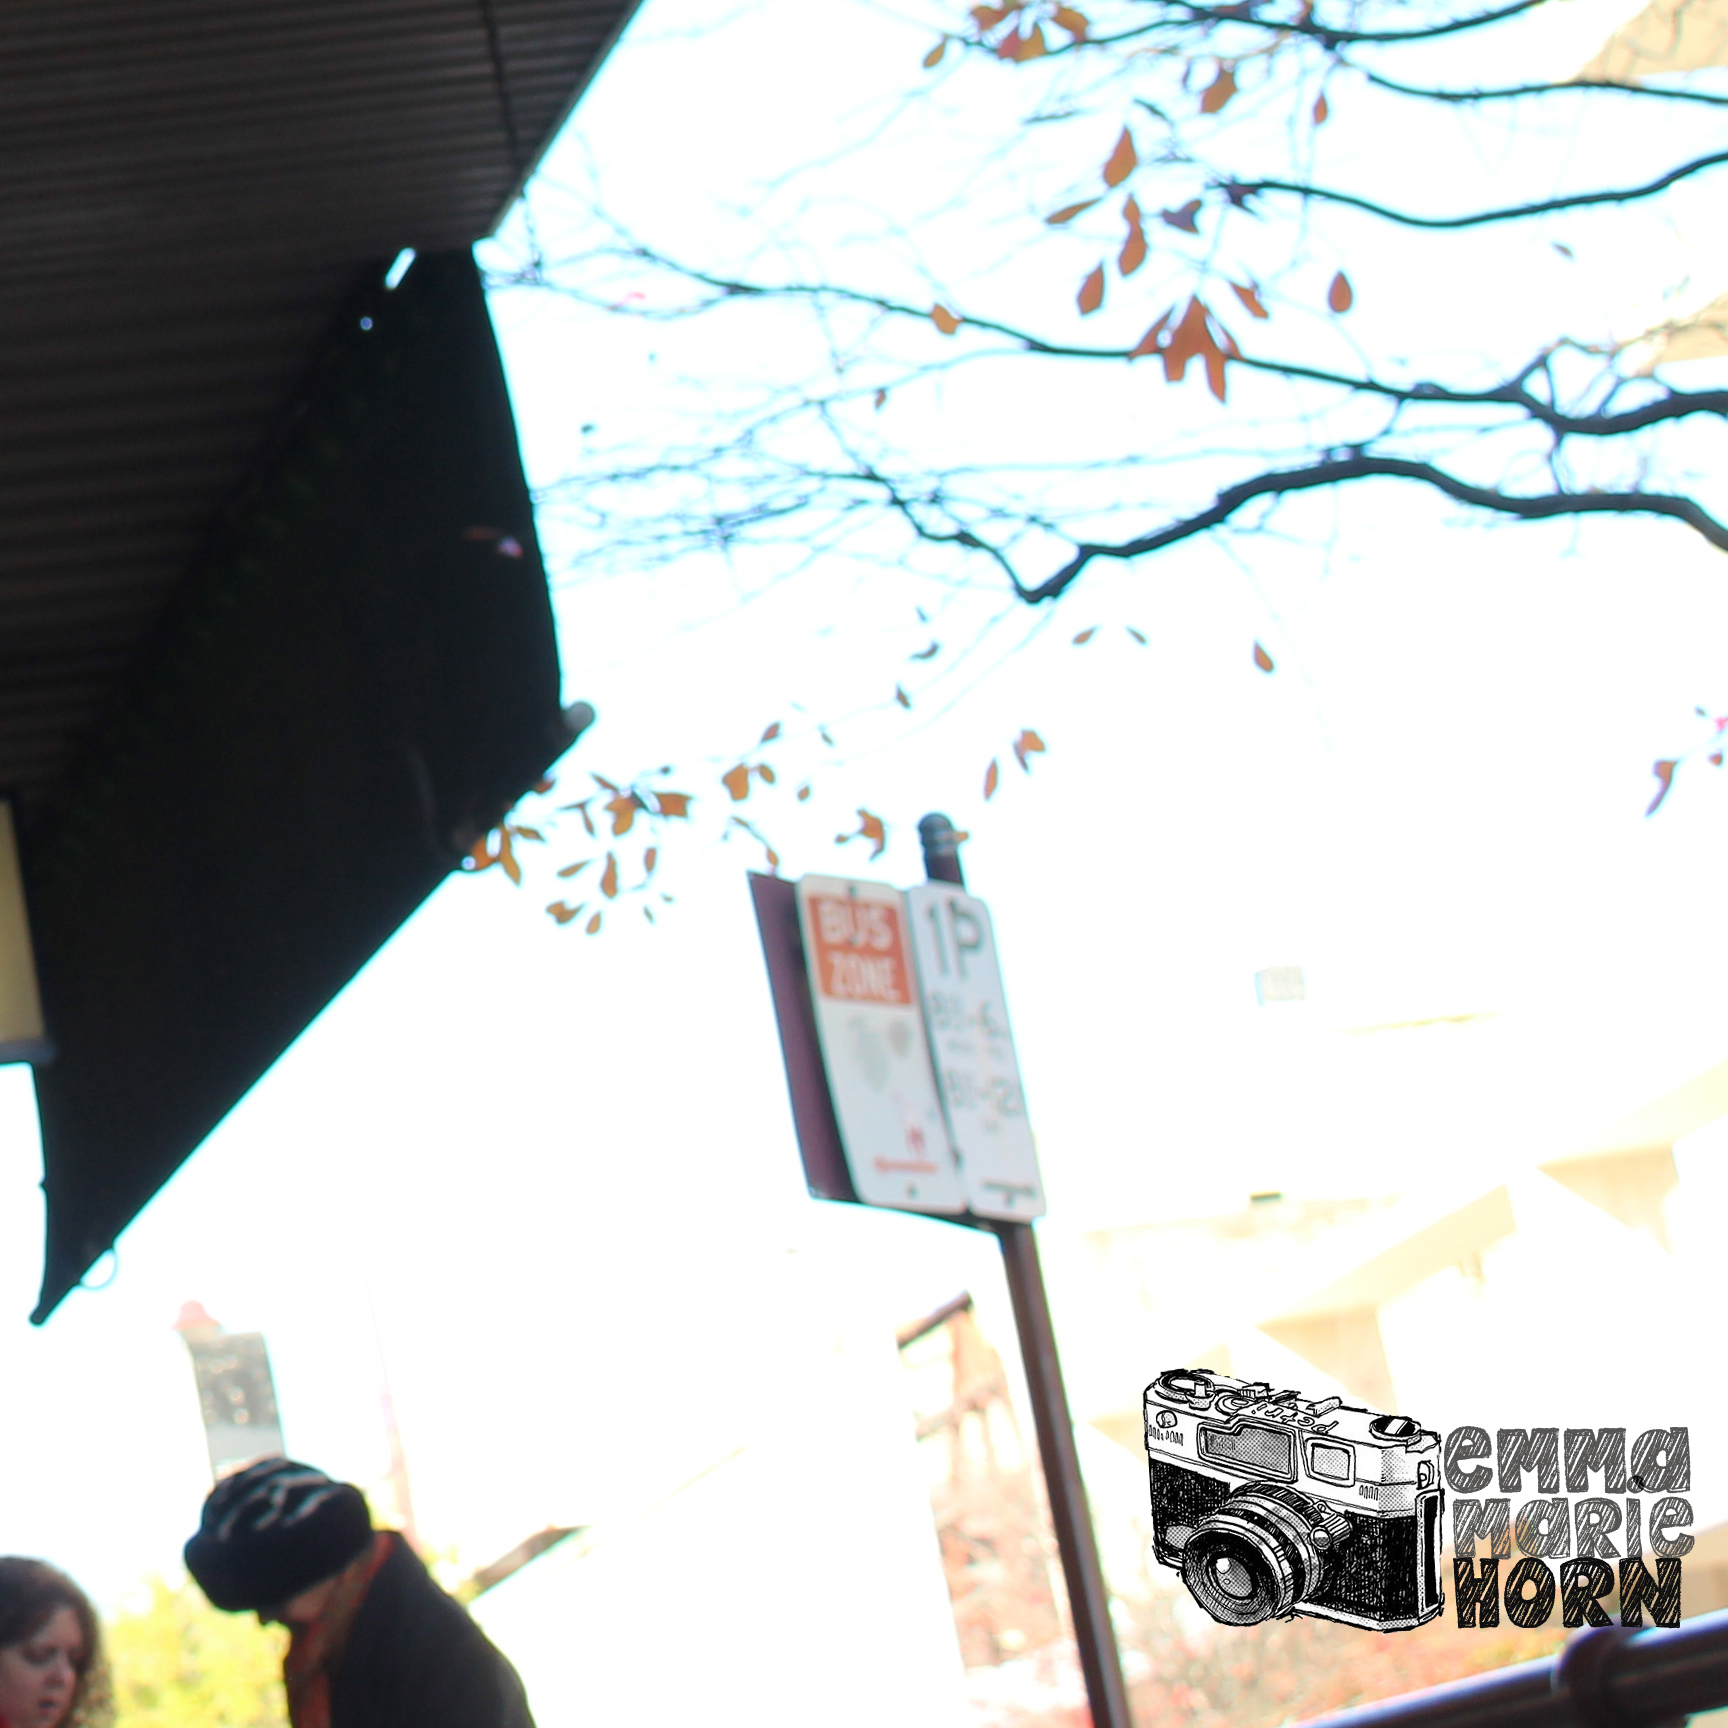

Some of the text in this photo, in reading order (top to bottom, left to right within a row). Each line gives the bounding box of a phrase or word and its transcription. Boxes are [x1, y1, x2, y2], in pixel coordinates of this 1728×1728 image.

[817, 899, 894, 952] BUS
[925, 897, 984, 980] 1P
[827, 952, 902, 1001] ZONE
